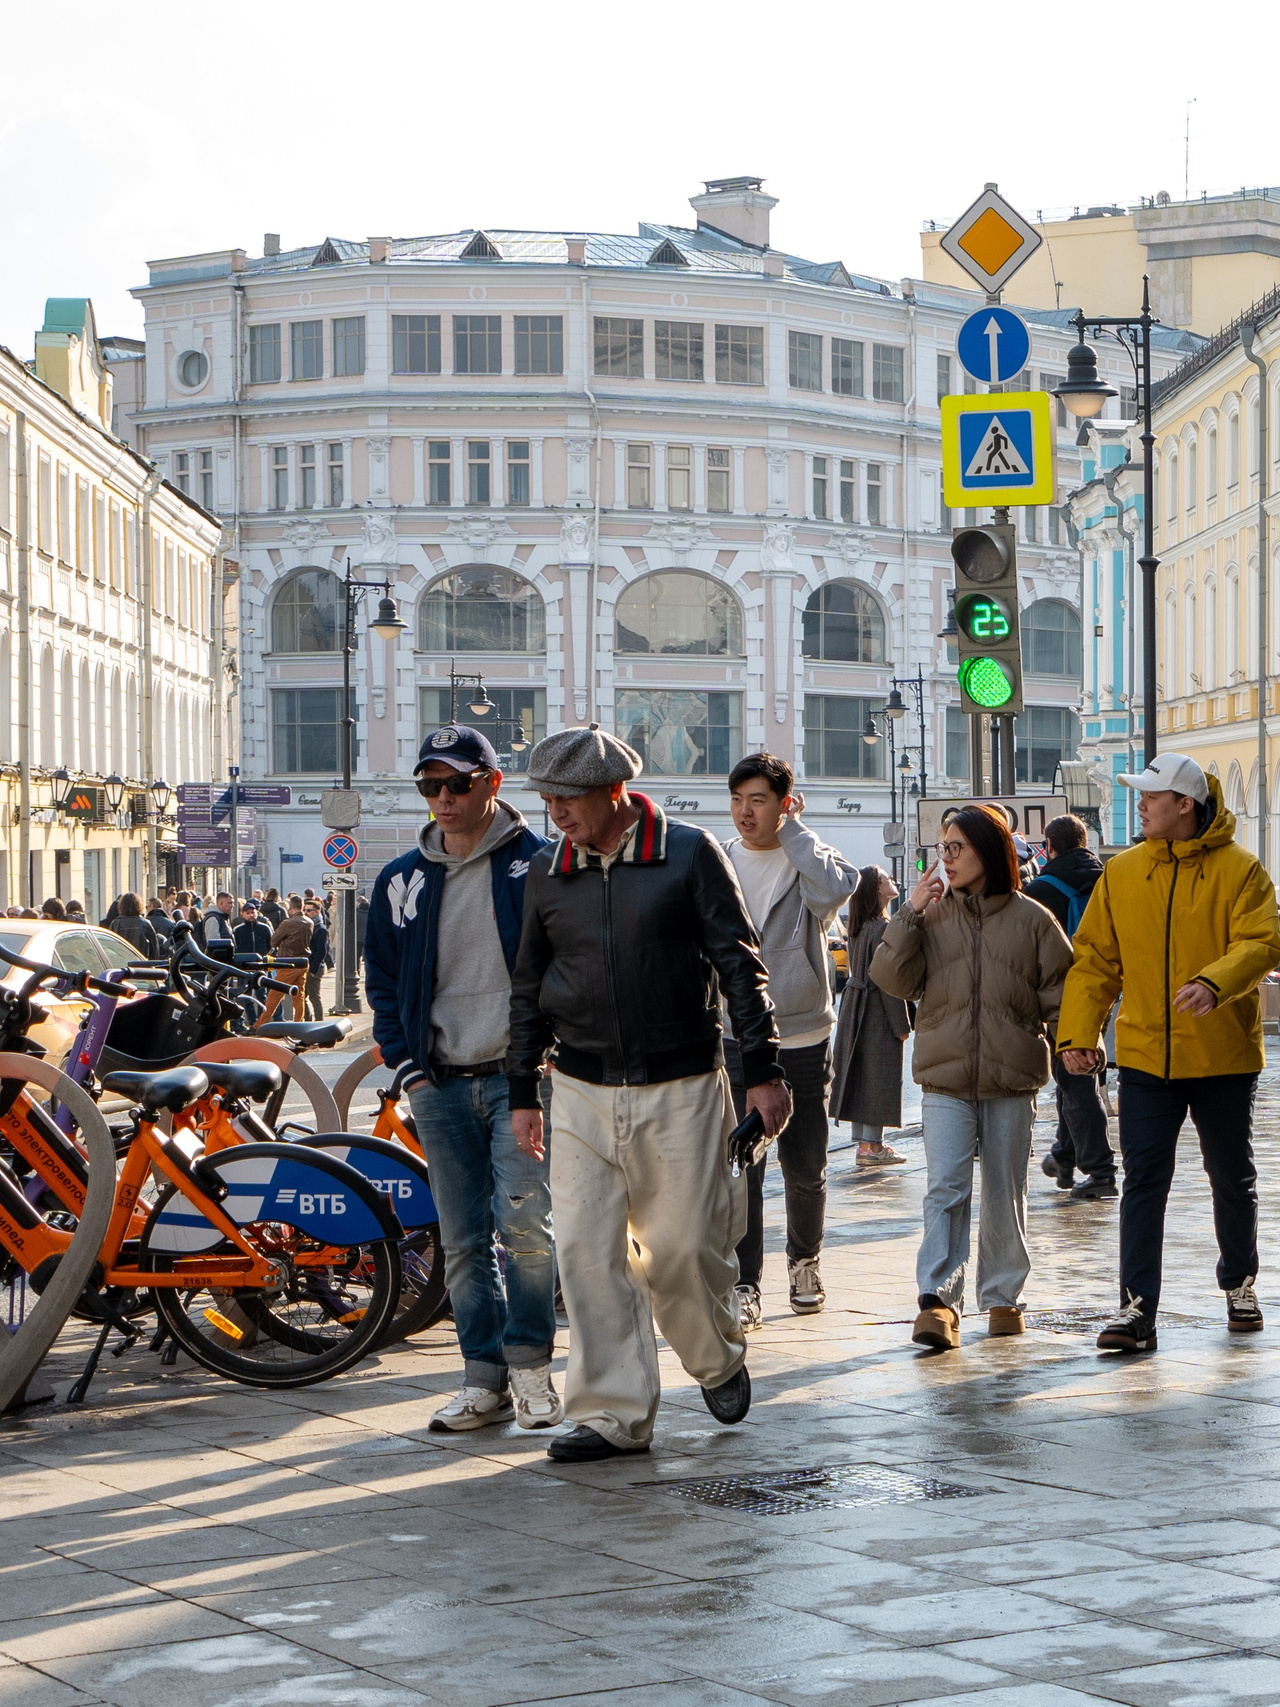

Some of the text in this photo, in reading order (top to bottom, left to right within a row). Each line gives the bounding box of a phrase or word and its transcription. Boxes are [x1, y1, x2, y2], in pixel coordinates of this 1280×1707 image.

[84, 1024, 97, 1051] ЮРЕНТ
[117, 1198, 132, 1209] 2.0
[299, 1194, 347, 1215] ВТБ
[183, 1277, 213, 1285] 21638
